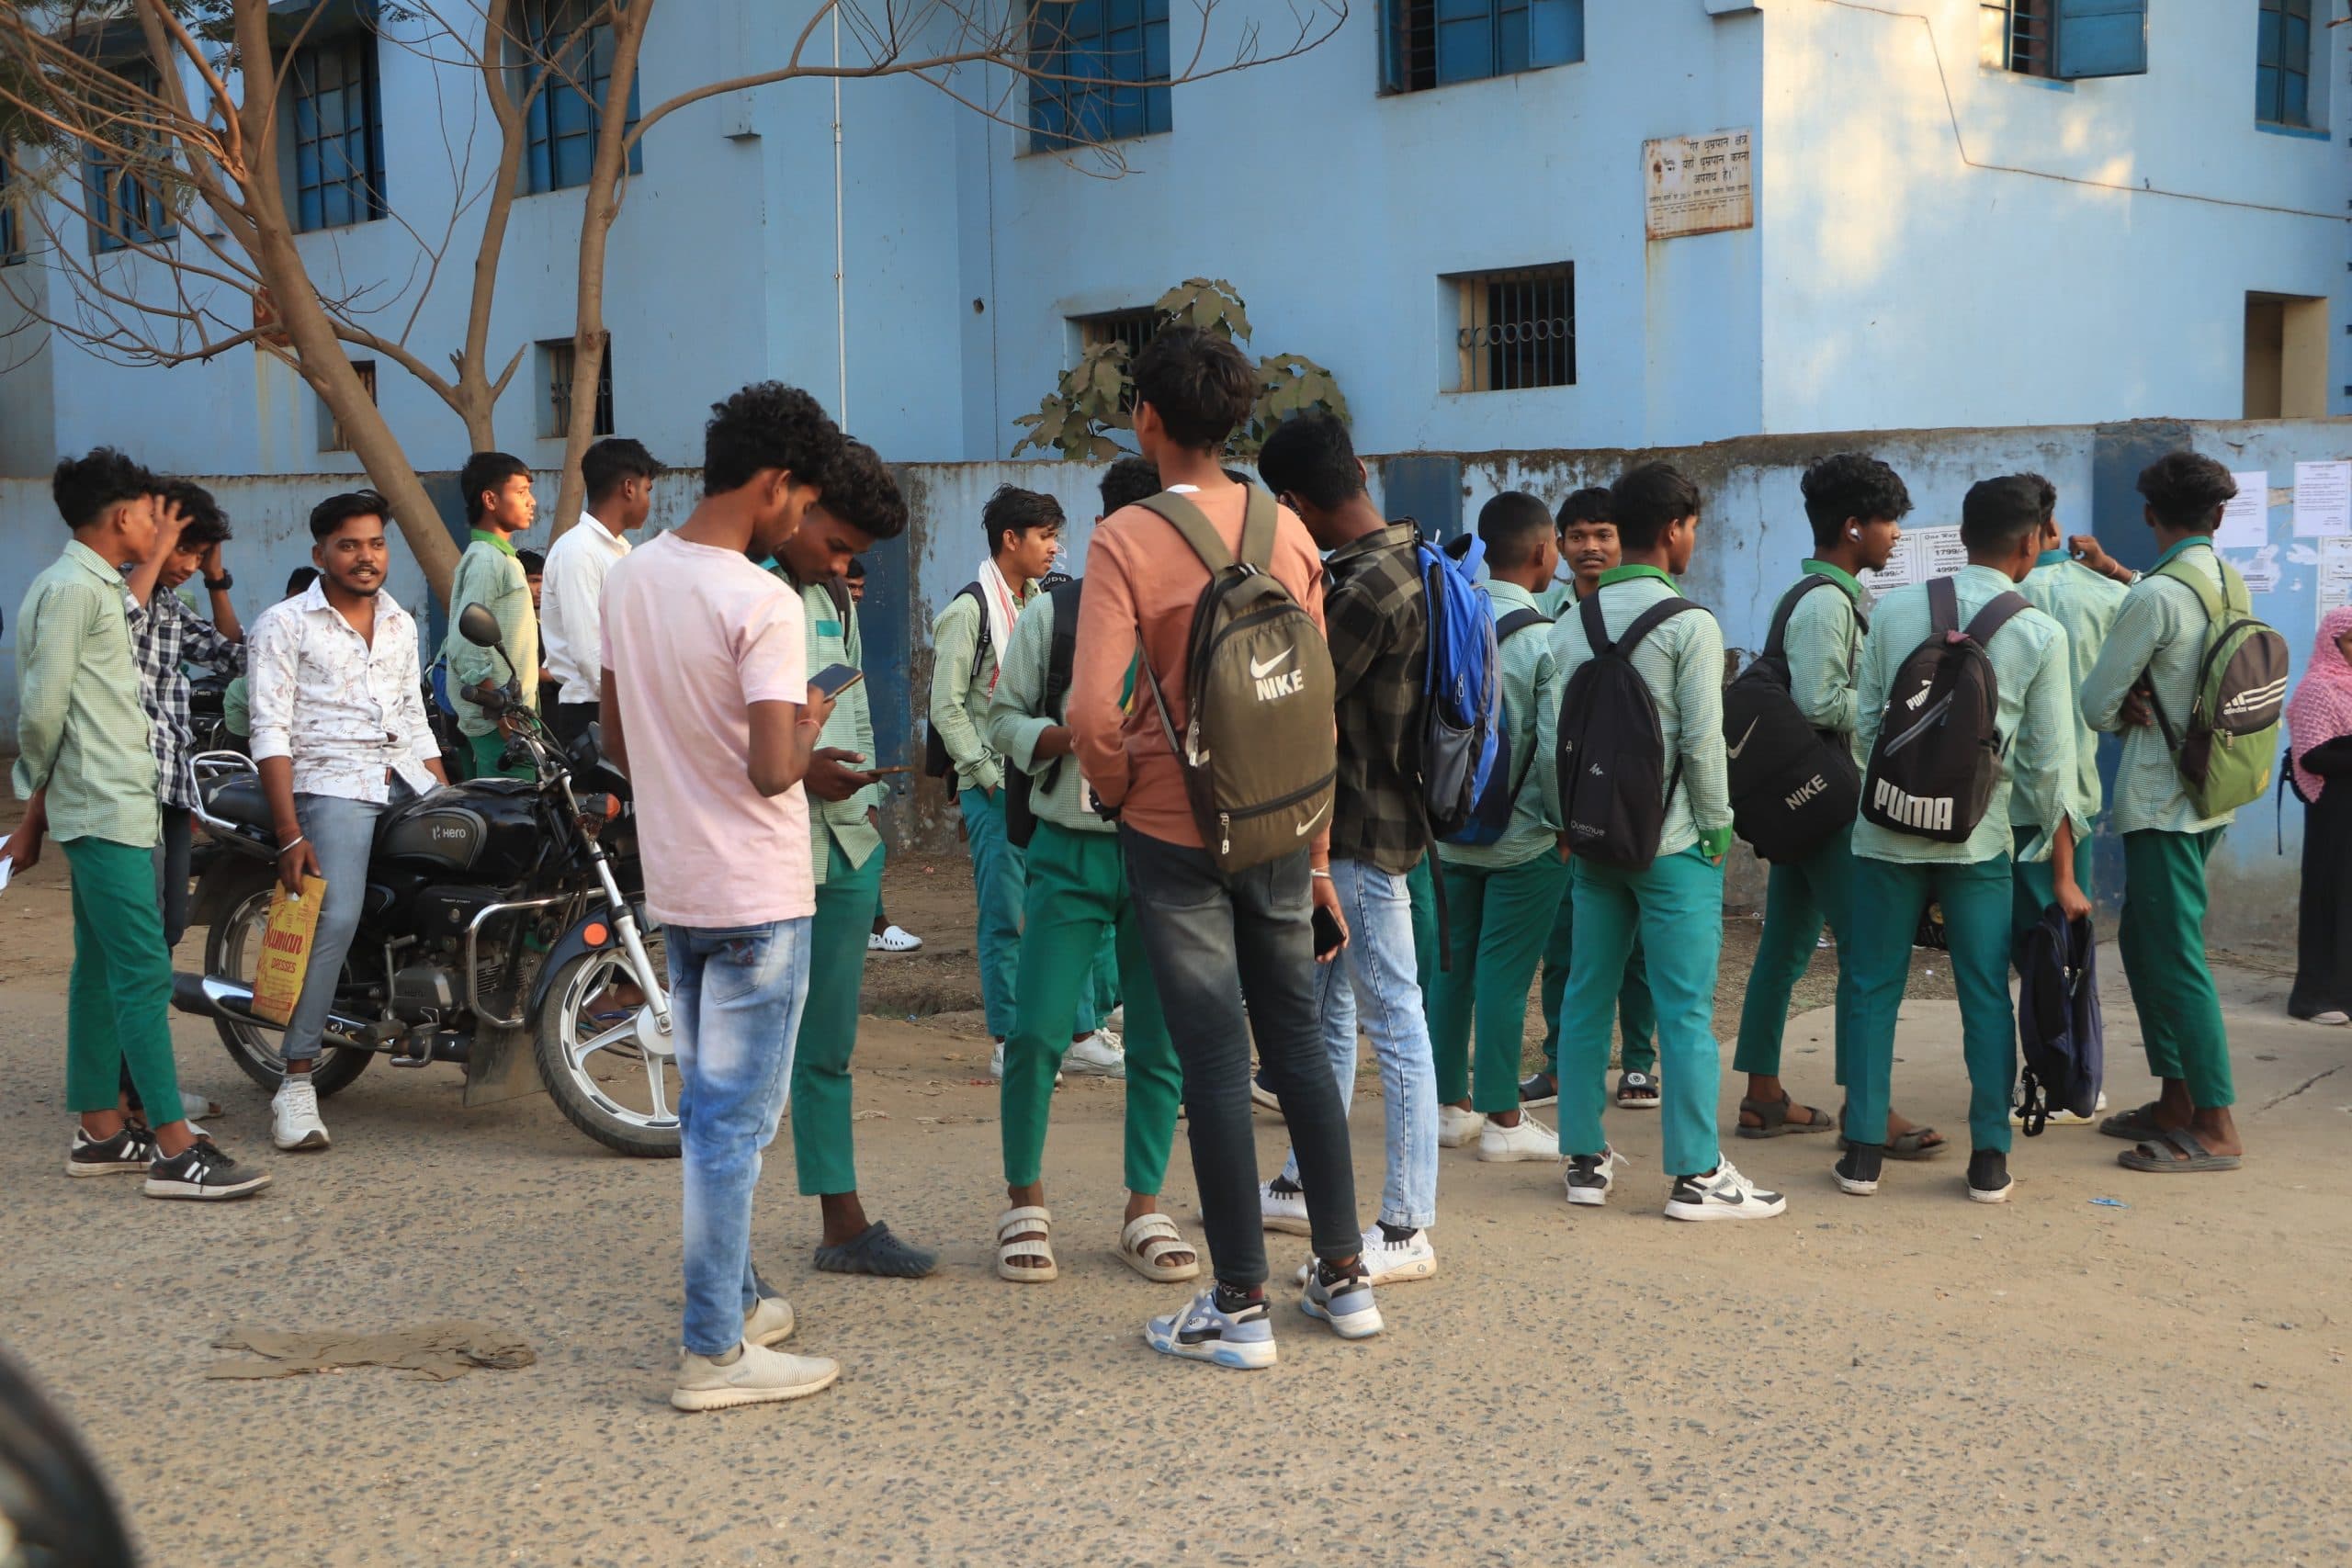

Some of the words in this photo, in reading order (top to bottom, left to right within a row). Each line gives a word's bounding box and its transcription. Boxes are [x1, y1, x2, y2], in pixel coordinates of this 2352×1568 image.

[1255, 669, 1305, 702] NIKE
[1905, 686, 1931, 712] PUM
[1784, 773, 1828, 811] NIKE
[1873, 777, 1954, 831] PUMA
[442, 828, 467, 839] Hero
[271, 957, 297, 974] DRESSES
